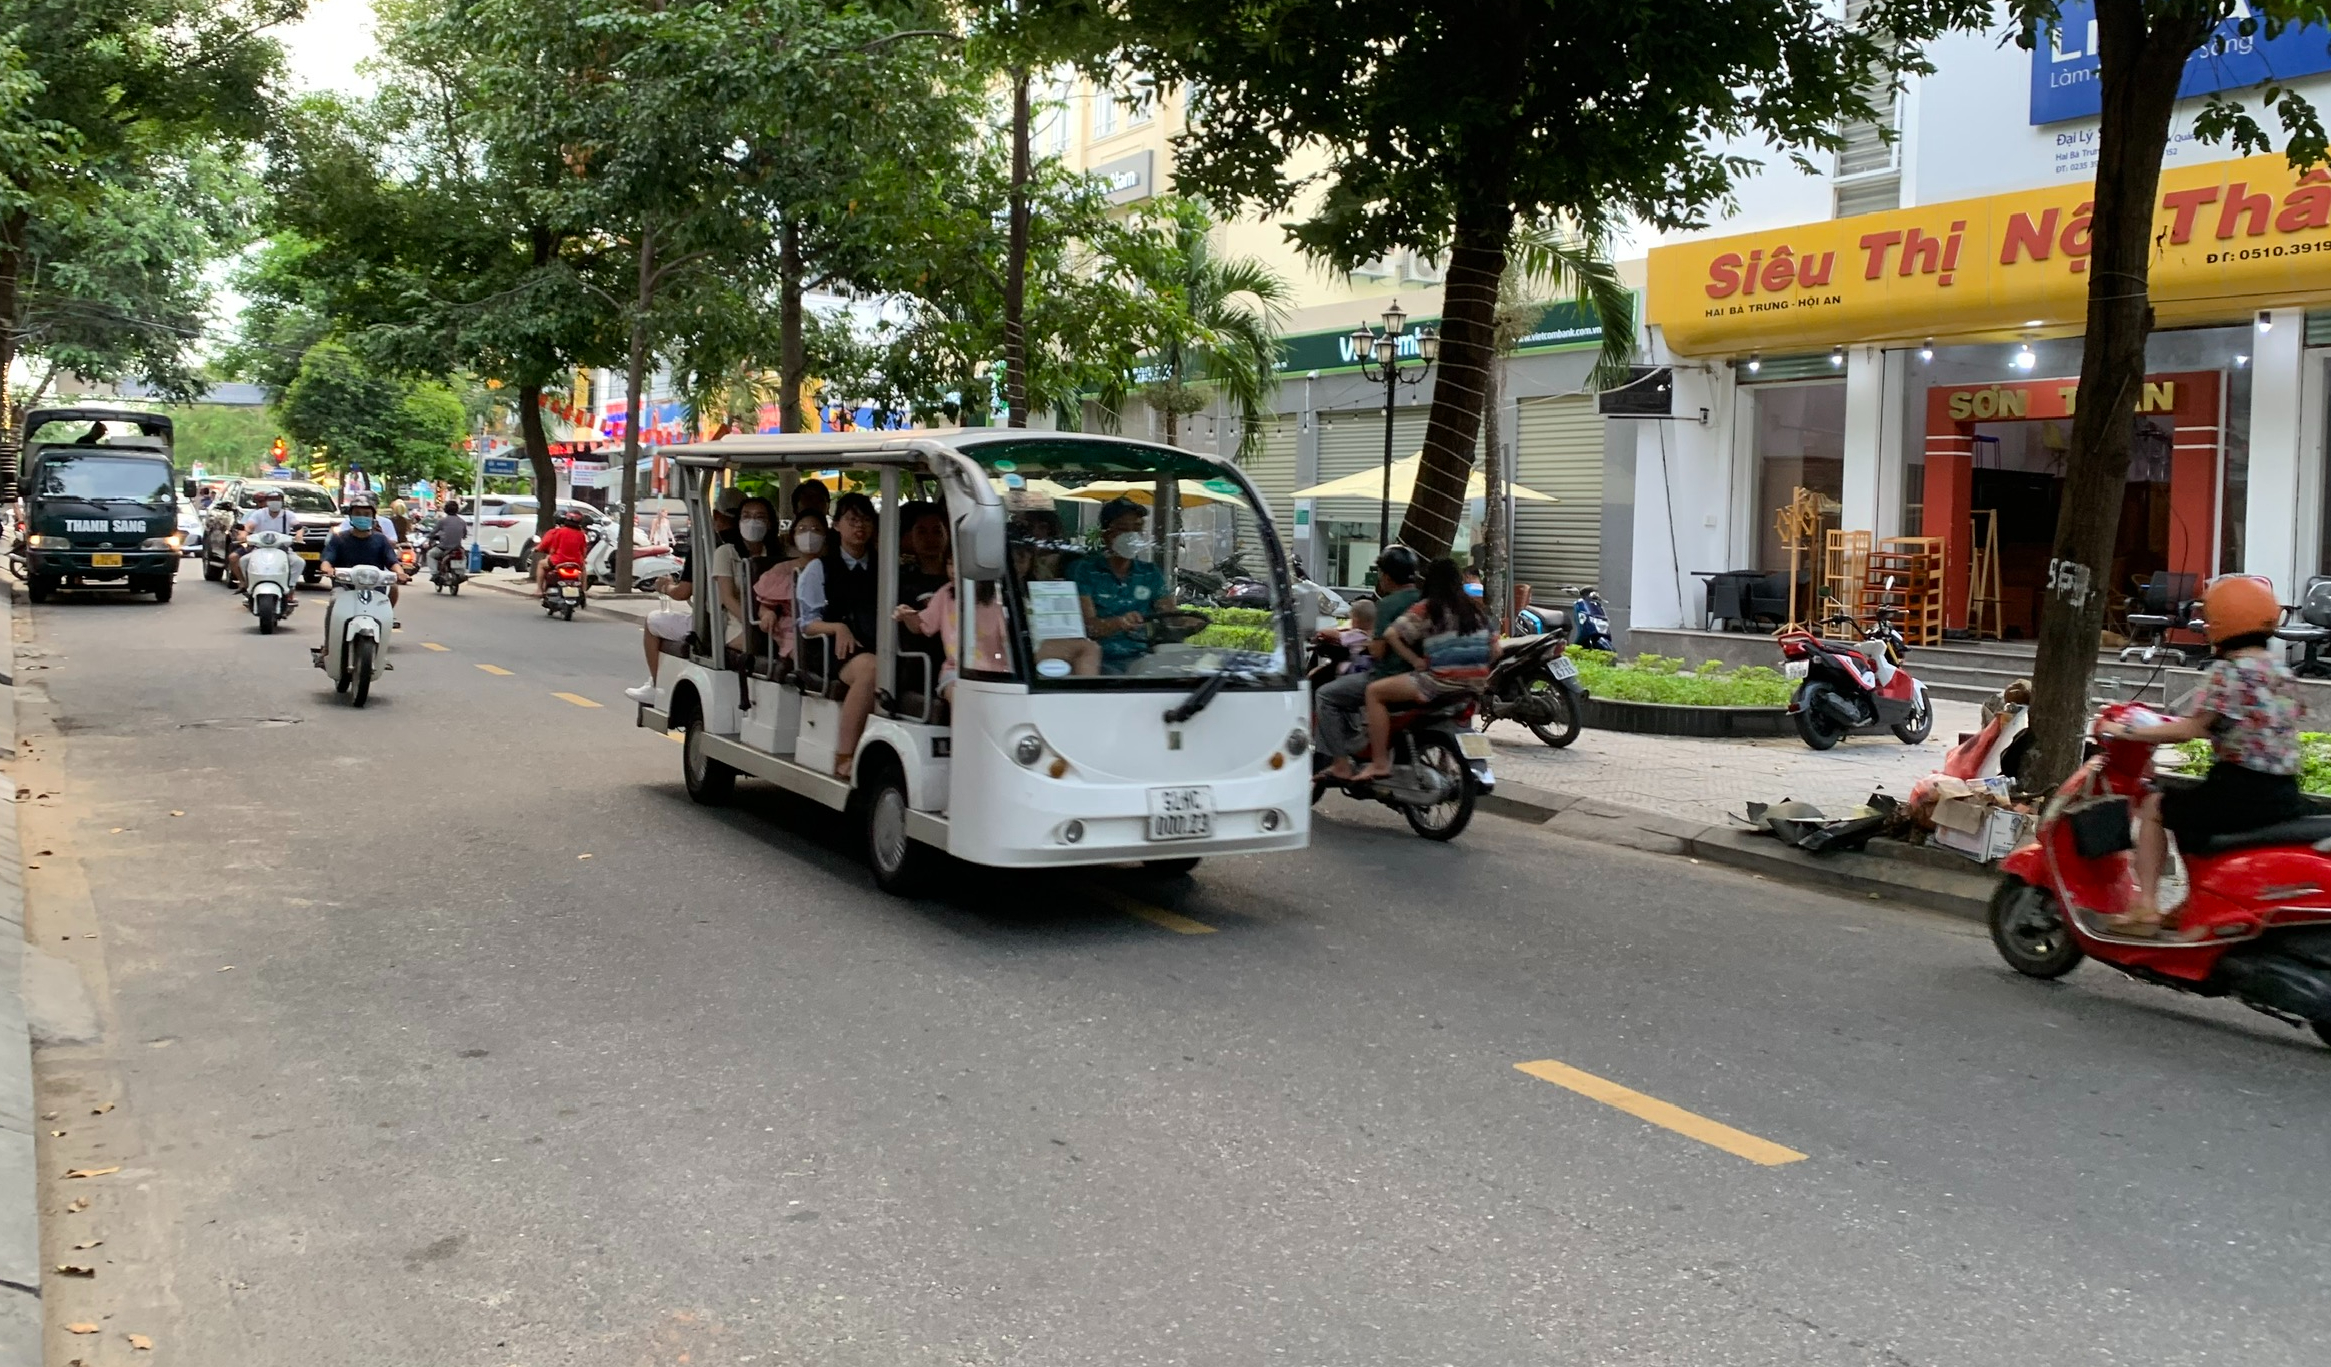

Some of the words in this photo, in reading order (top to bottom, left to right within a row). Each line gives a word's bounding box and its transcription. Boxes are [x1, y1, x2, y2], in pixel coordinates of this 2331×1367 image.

[2051, 64, 2090, 88] Làm
[2056, 132, 2076, 147] Đại
[2080, 129, 2093, 144] Lý
[2056, 152, 2068, 161] Hai
[1705, 244, 1837, 299] Siêu
[1859, 220, 1967, 287] Thị
[2000, 201, 2095, 273] Nộ
[2239, 240, 2331, 260] 0510.3919
[1705, 308, 1724, 318] HAI
[1729, 303, 1744, 315] BÀ
[1748, 301, 1789, 313] TRƯNG
[1798, 295, 1819, 308] HỘI
[1823, 295, 1841, 305] AN
[1949, 385, 2028, 420] SƠN
[2058, 381, 2174, 416] TN
[65, 519, 109, 533] THANH
[112, 519, 146, 533] SANG
